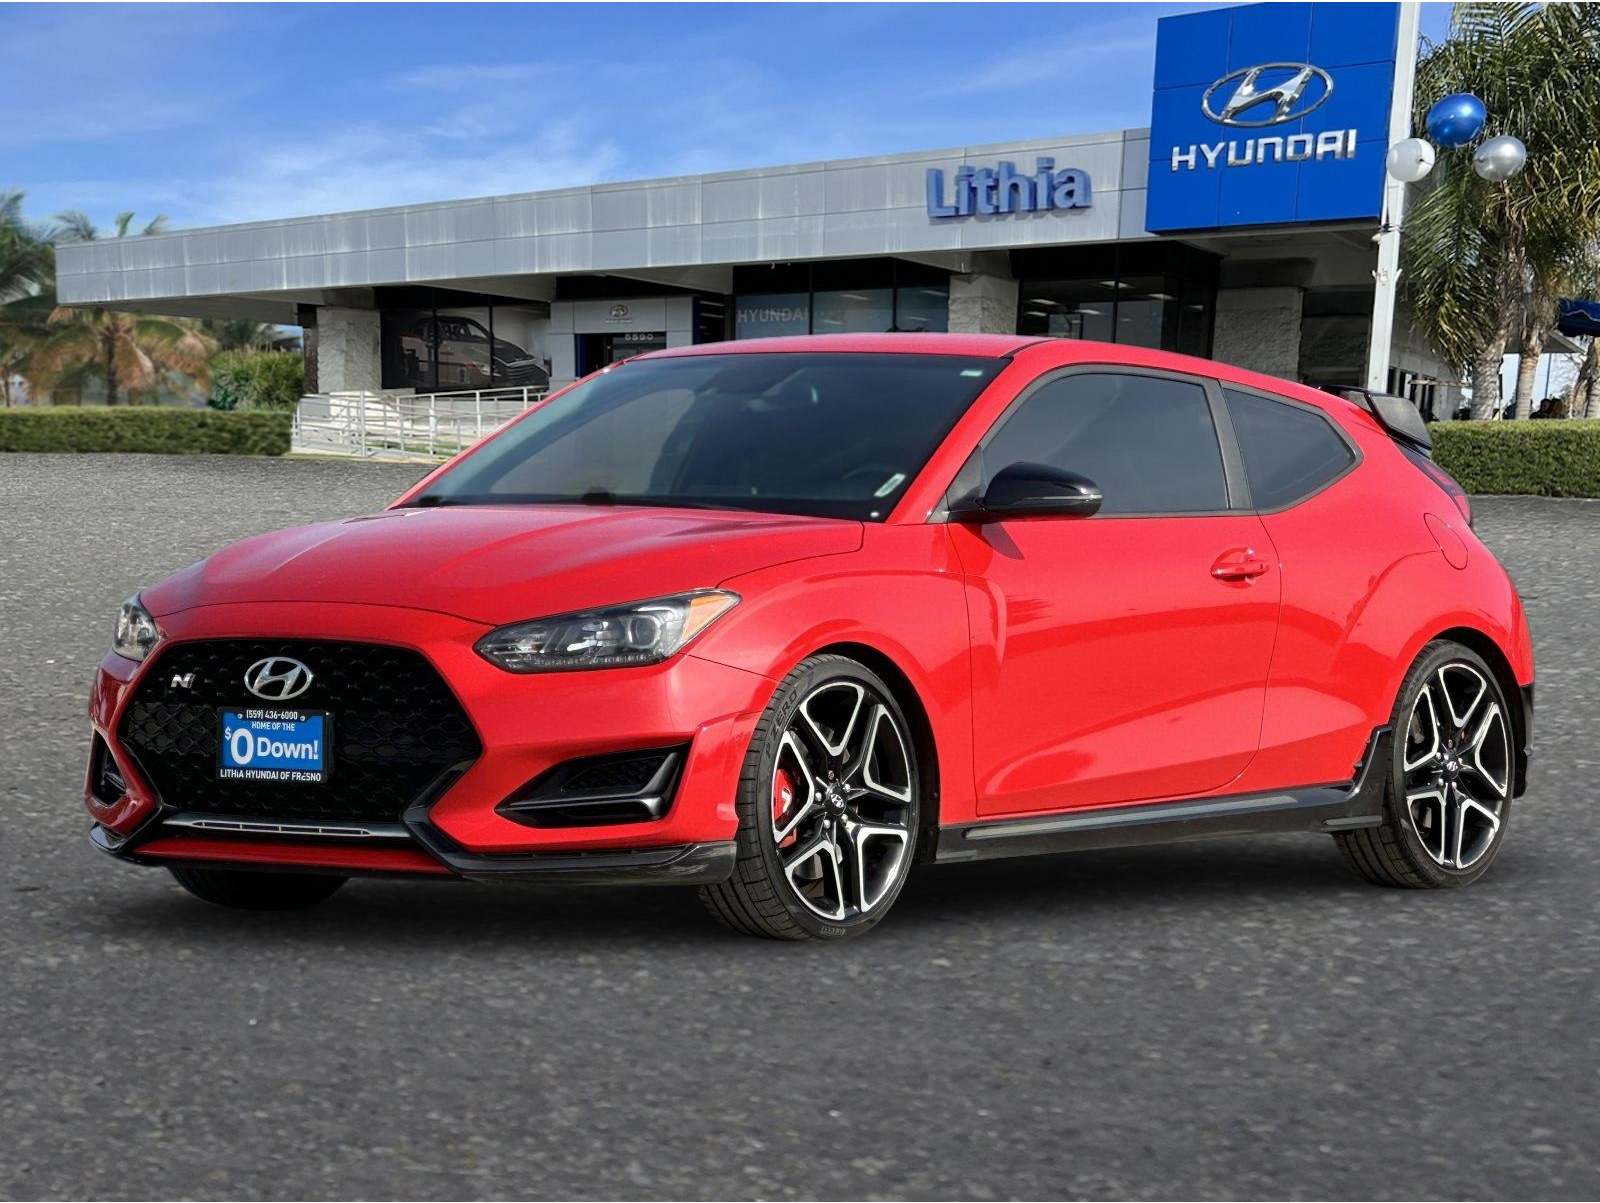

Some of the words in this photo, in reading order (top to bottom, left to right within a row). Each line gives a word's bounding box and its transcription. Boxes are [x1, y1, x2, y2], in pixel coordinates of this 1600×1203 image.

[1171, 129, 1357, 171] HYUNDAI
[926, 157, 1092, 217] Lithia
[737, 306, 809, 323] HYUNDAI
[246, 709, 264, 719] (559)
[264, 710, 298, 720] 436-6000
[251, 721, 271, 729] HOME
[271, 722, 281, 731] OF
[282, 722, 296, 732] THE
[256, 736, 319, 760] Down!
[245, 769, 279, 780] HYUNDAI
[279, 771, 290, 780] OF
